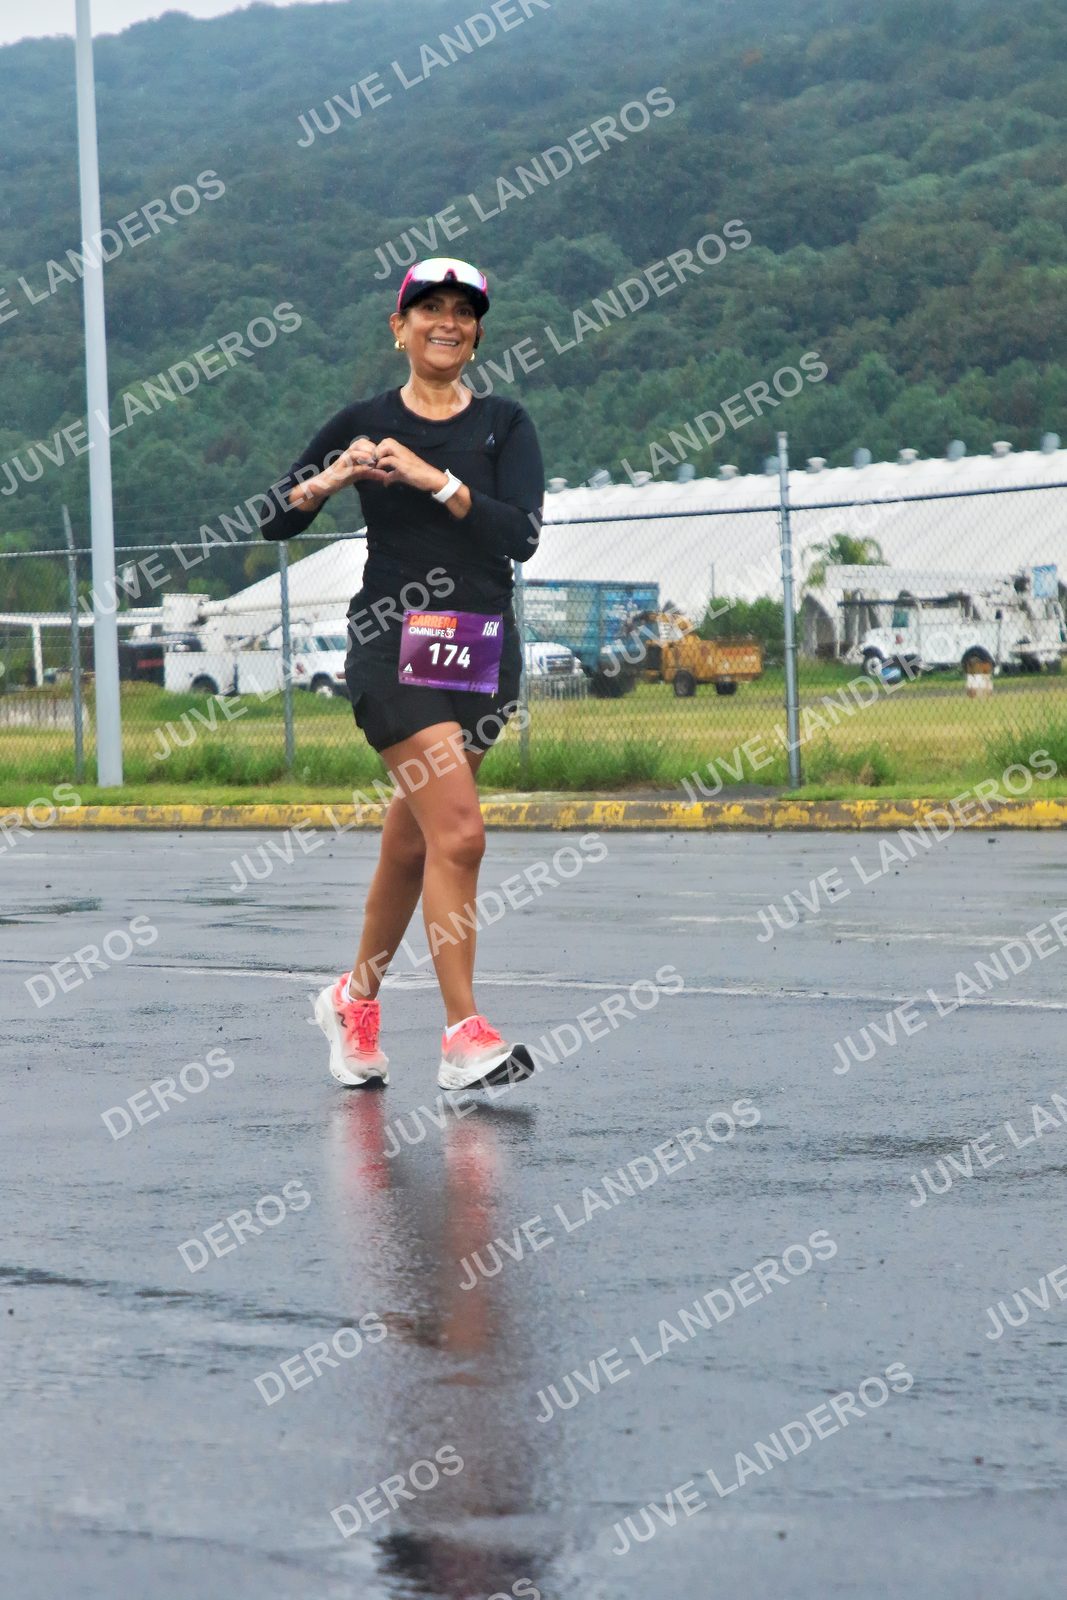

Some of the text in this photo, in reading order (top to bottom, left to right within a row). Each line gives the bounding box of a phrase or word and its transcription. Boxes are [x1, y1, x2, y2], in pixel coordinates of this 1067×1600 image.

[409, 614, 458, 629] CARRERA
[482, 621, 500, 637] 15K
[408, 626, 445, 638] OMNILIFE
[429, 642, 471, 669] 174
